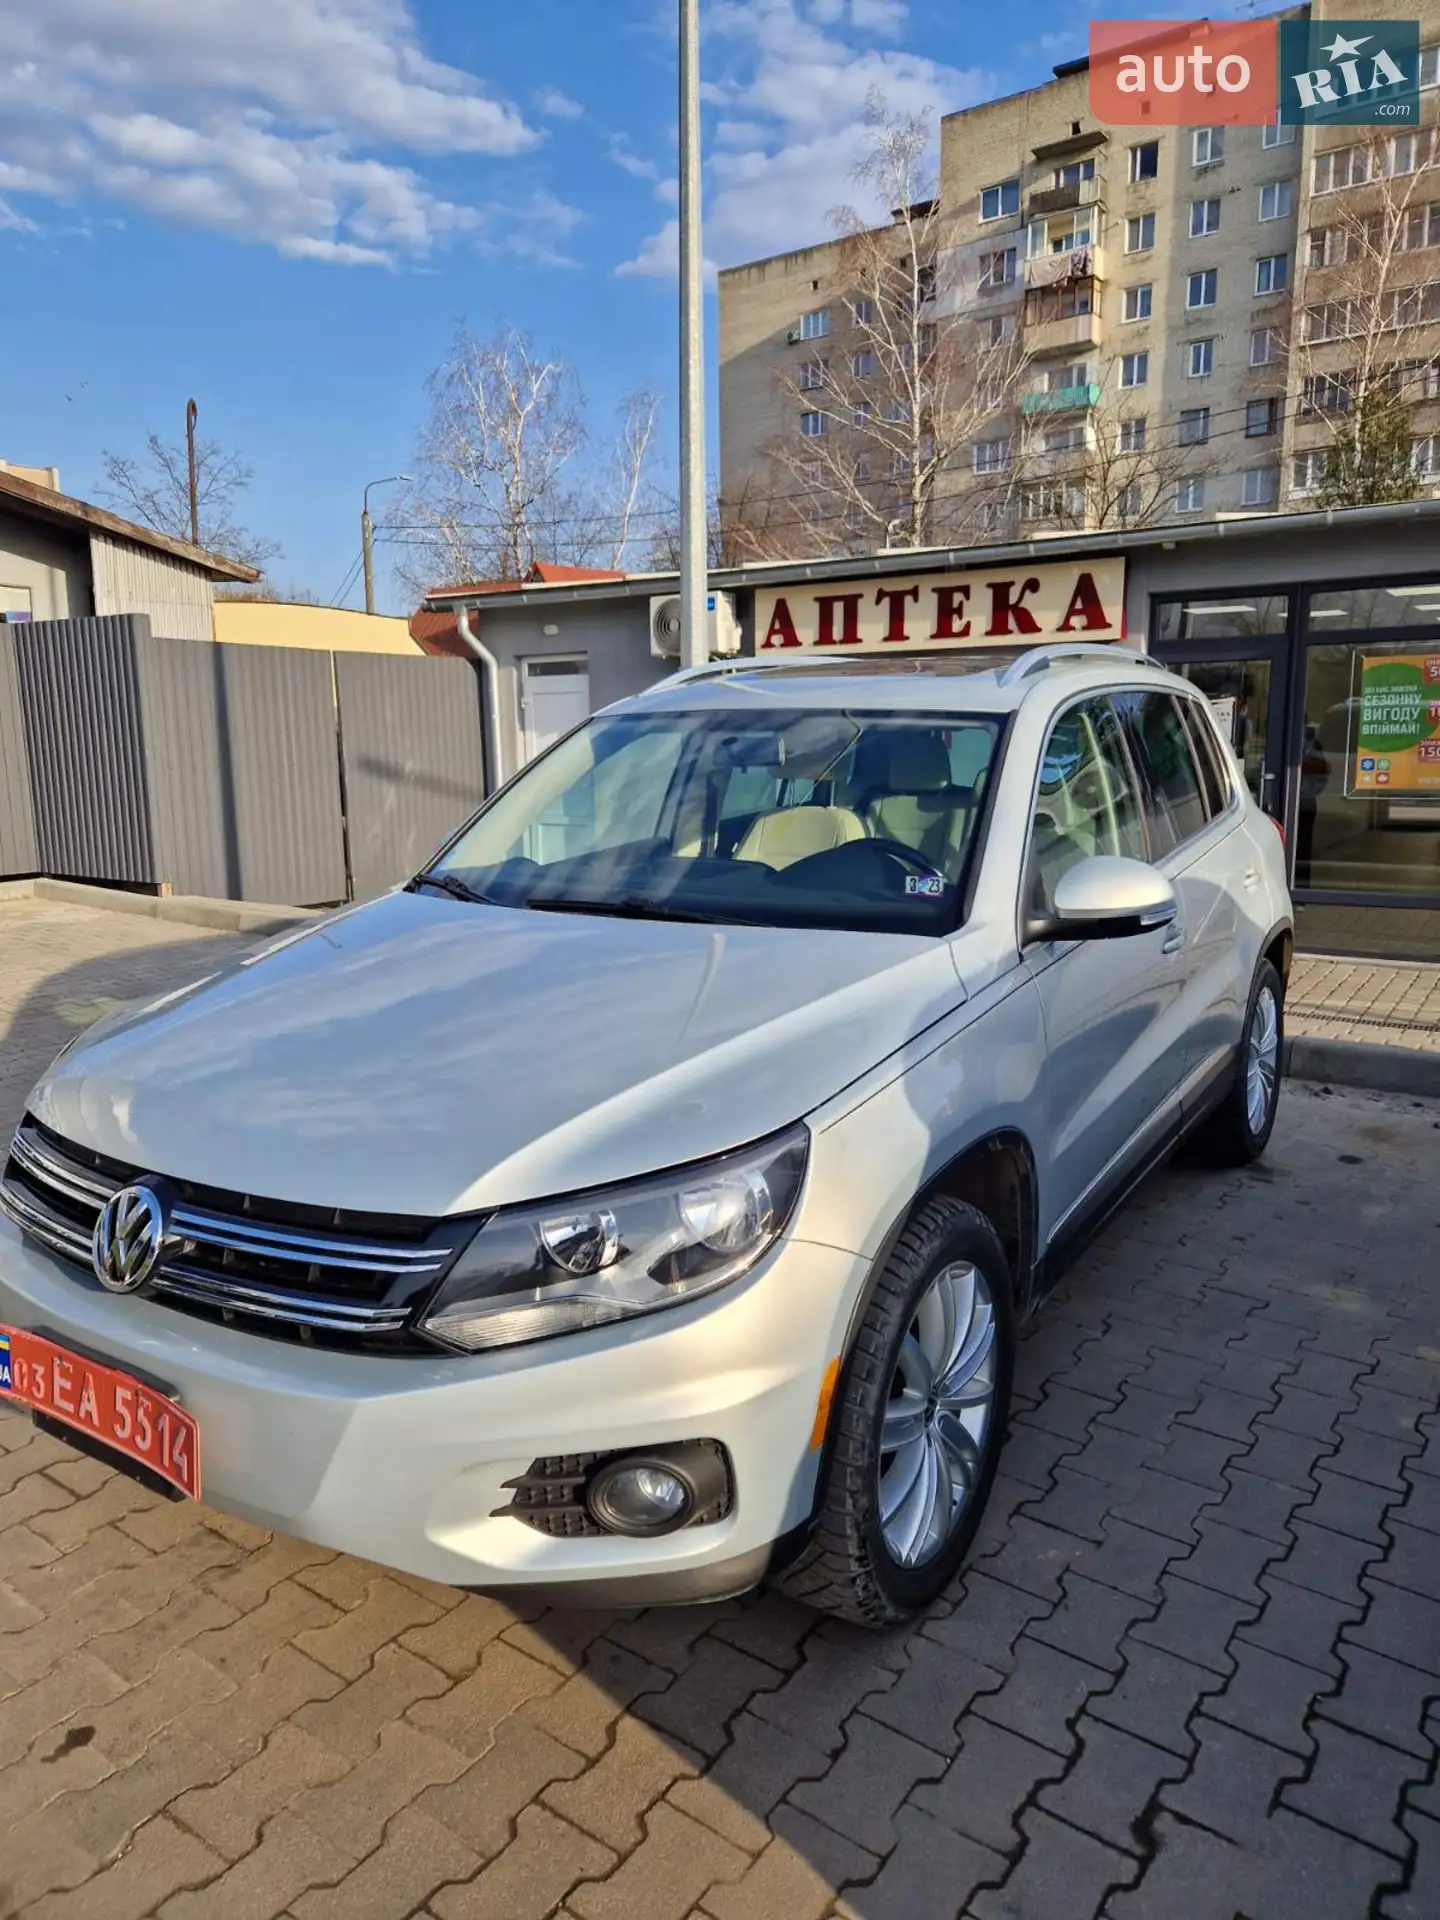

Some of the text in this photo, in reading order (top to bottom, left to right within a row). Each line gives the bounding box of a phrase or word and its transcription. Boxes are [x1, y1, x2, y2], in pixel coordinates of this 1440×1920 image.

[761, 572, 1112, 649] АПТЕКА
[1363, 707, 1421, 722] ВИГОДУ
[928, 878, 940, 893] 23
[113, 1386, 188, 1483] 5514
